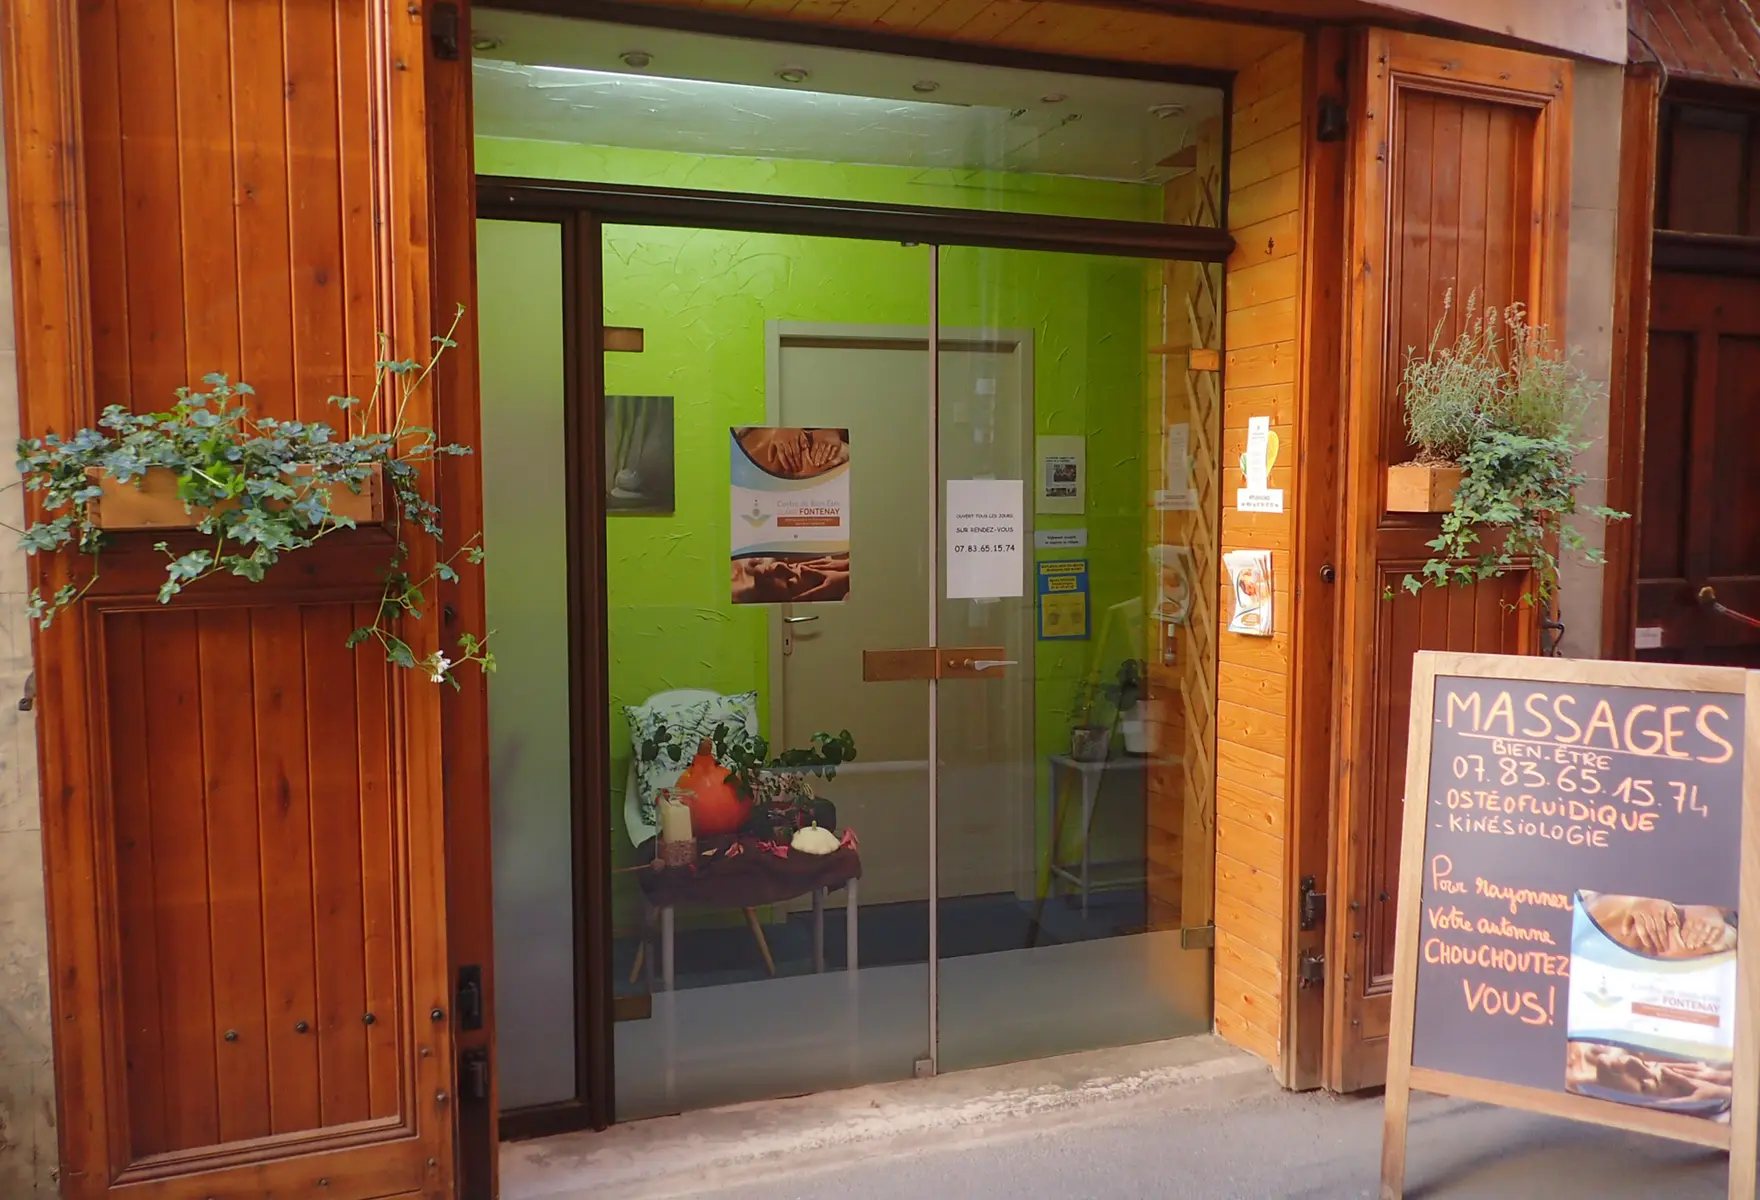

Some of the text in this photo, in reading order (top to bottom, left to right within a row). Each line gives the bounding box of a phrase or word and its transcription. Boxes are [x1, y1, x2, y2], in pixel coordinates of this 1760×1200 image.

[954, 544, 1015, 552] 07.83.65.15.74
[1447, 691, 1734, 764] MASSAGES
[1432, 854, 1574, 915] Pour rayonner
[1477, 916, 1556, 945] automne
[1424, 938, 1570, 977] CHOUCHOUTEZ
[1663, 996, 1720, 1012] FONTENAY
